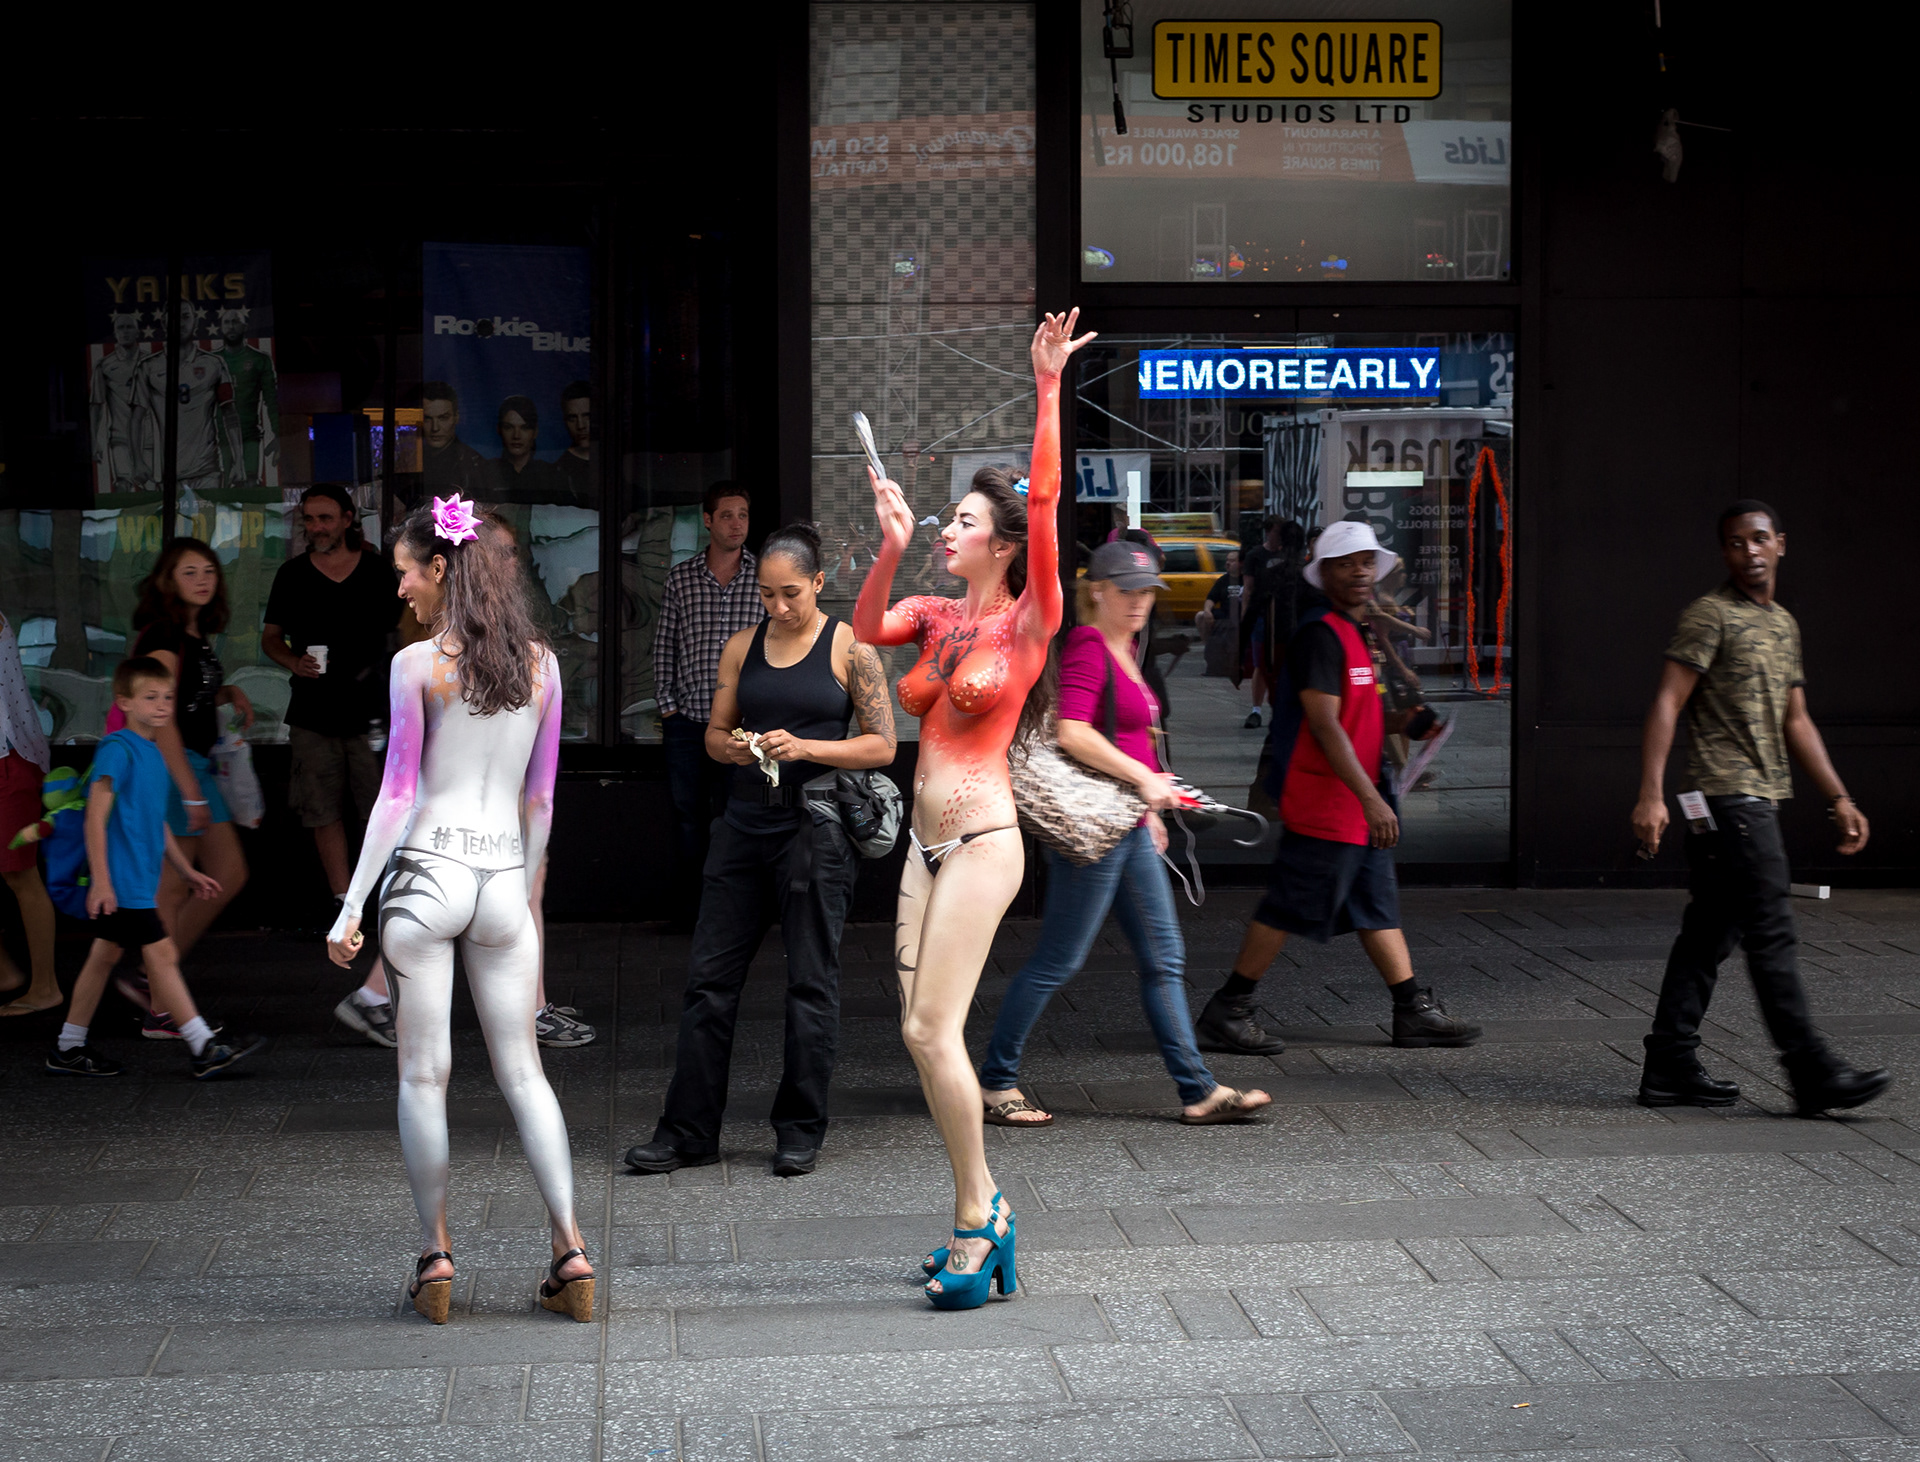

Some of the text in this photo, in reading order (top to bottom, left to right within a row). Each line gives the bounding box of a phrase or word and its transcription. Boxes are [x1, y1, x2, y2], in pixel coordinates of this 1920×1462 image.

[1166, 32, 1429, 86] TIMES SQUARE
[1186, 104, 1411, 124] STUDIOS LTD
